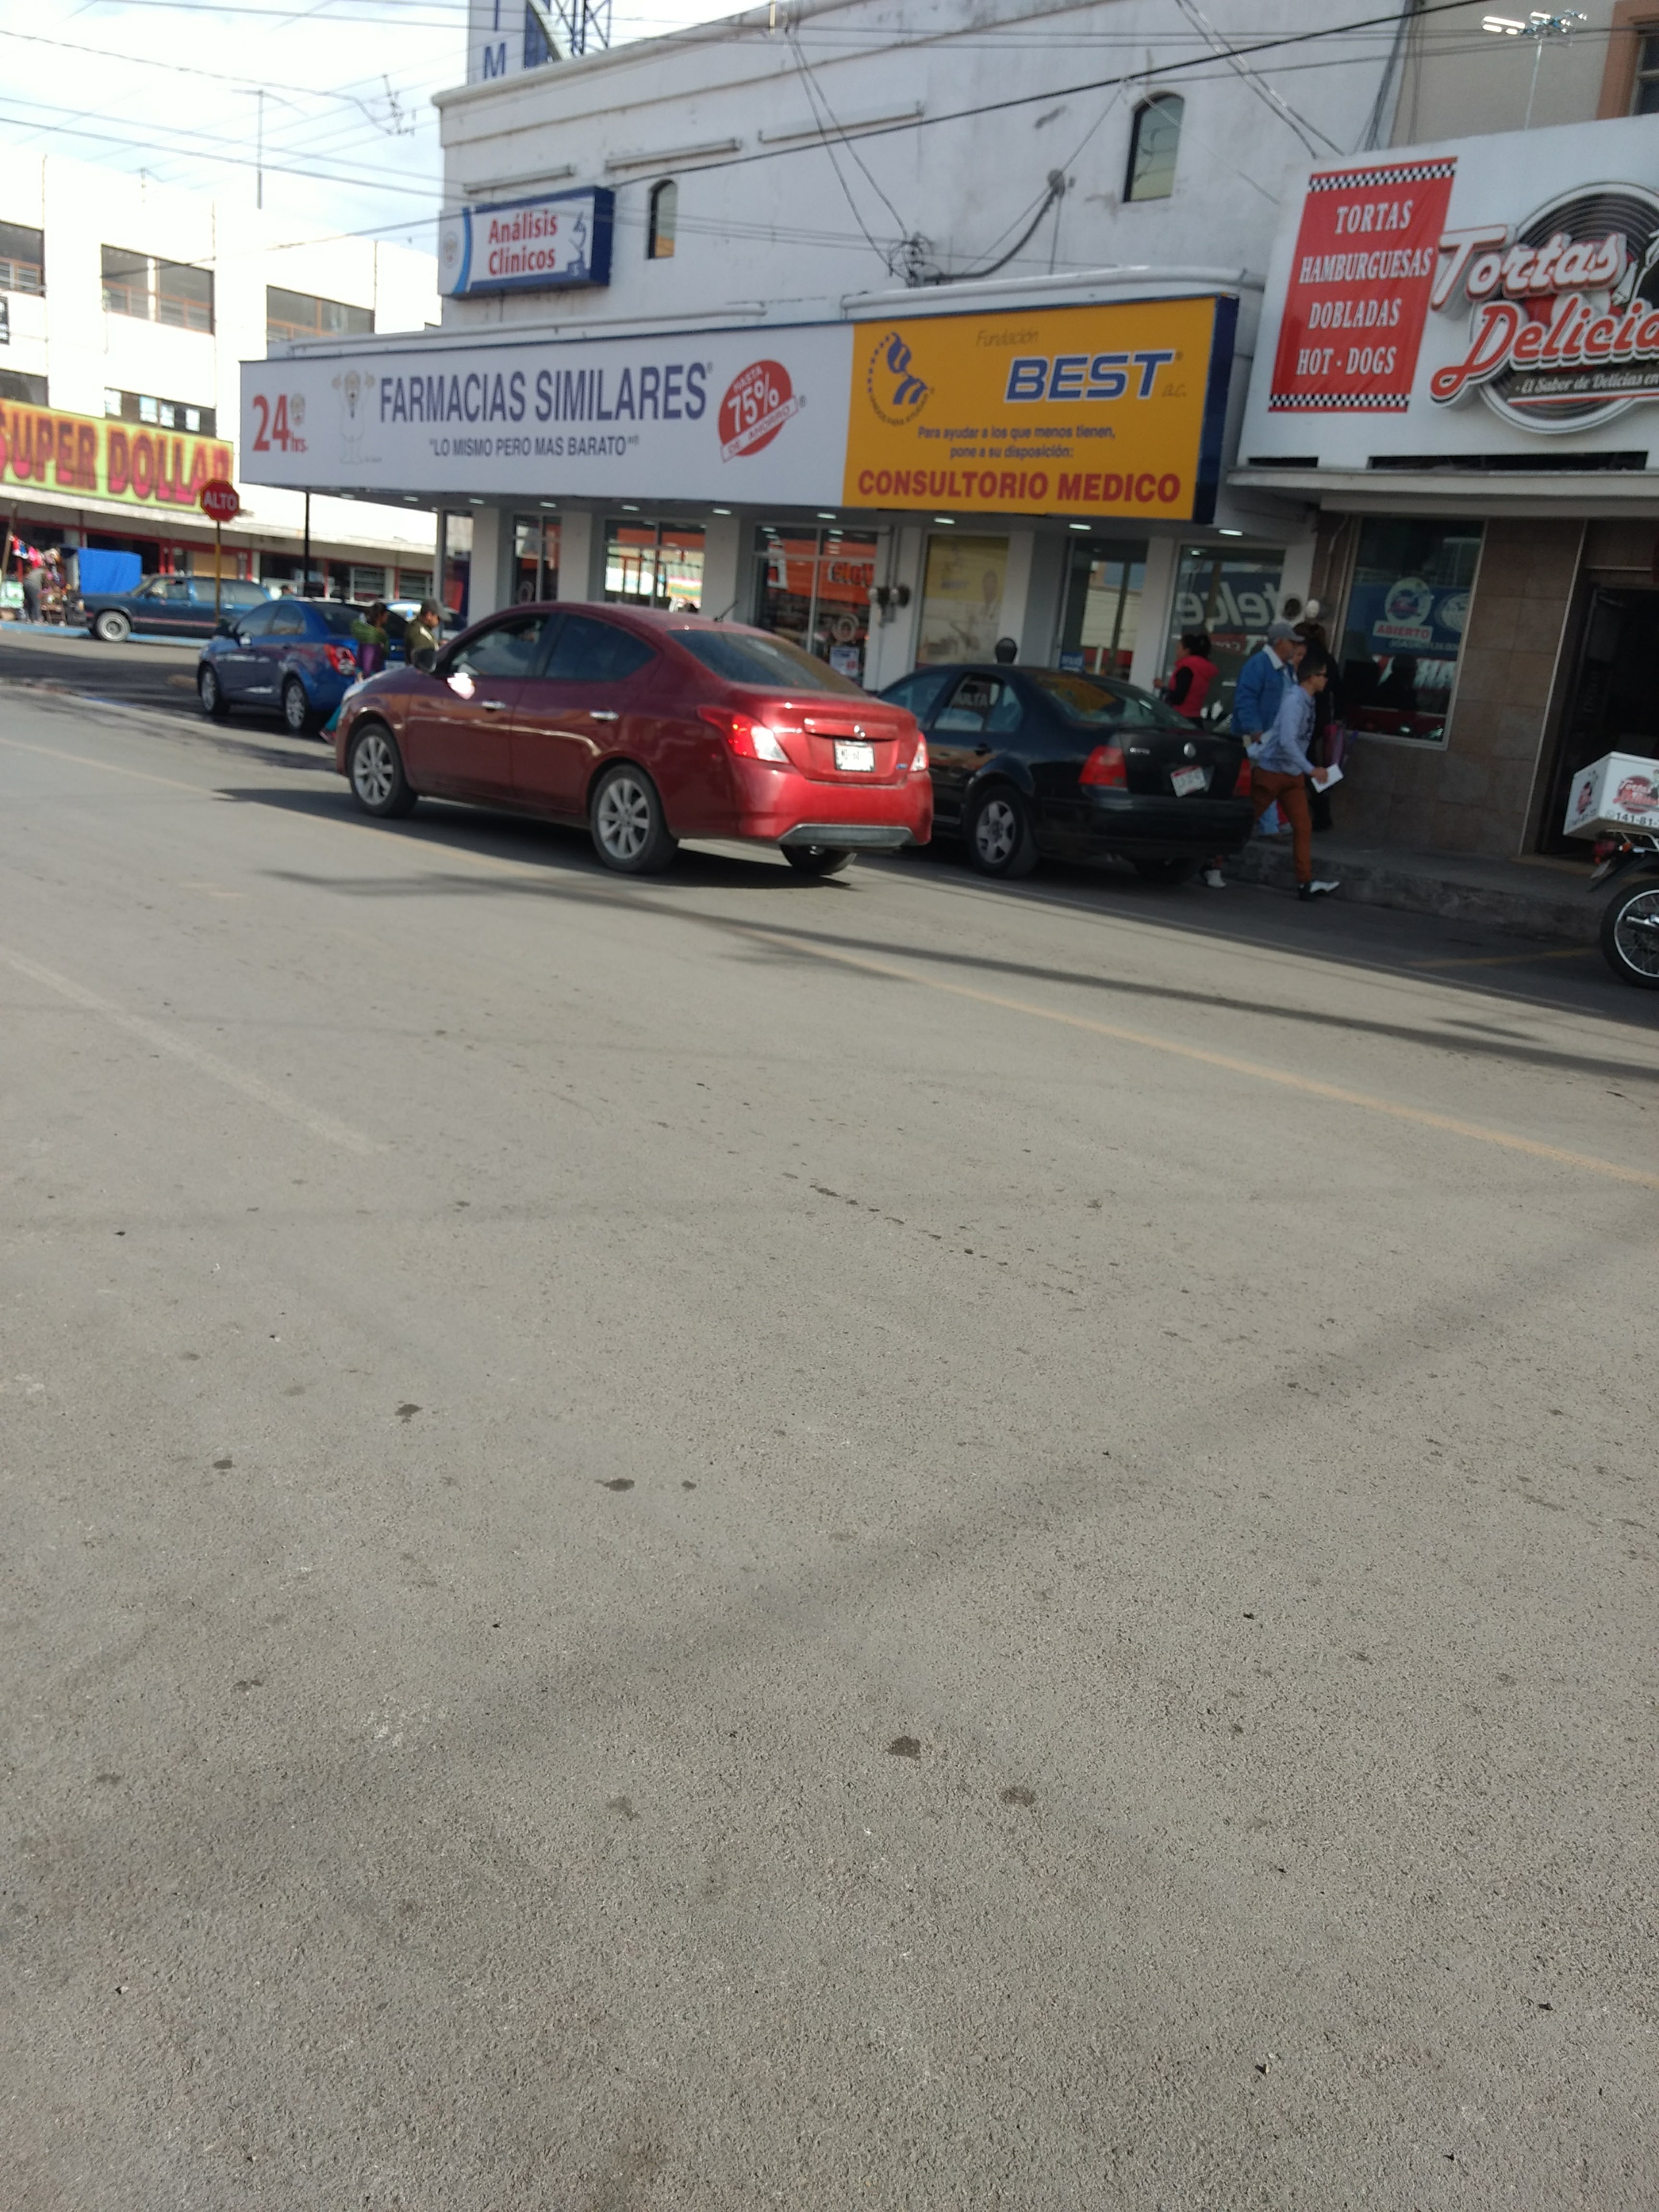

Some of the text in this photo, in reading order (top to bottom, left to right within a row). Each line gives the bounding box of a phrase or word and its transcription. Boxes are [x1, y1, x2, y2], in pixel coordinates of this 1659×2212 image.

[488, 208, 557, 245] Análisis
[1334, 199, 1413, 235] TORTAS
[1298, 246, 1433, 284] HAMBURGUESAS
[1431, 224, 1627, 311] Tortas
[1308, 298, 1402, 330] DOBLADAS
[1004, 349, 1175, 403] BEST
[1296, 346, 1397, 376] HOT DOGS
[380, 362, 707, 423] FARMACIAS SIMILARES
[727, 371, 780, 433] 75%
[252, 394, 291, 452] 24
[918, 425, 940, 439] Para
[943, 425, 979, 442] ayudar
[990, 424, 1008, 439] los
[1010, 427, 1032, 442] que
[1034, 427, 1073, 438] menos
[453, 437, 493, 457] MISMO
[496, 436, 531, 457] PERO
[535, 436, 564, 457] MAS
[202, 492, 238, 511] ALTO
[858, 469, 1182, 504] CONSULTORIO MEDICO
[1616, 812, 1659, 827] 141-81-
